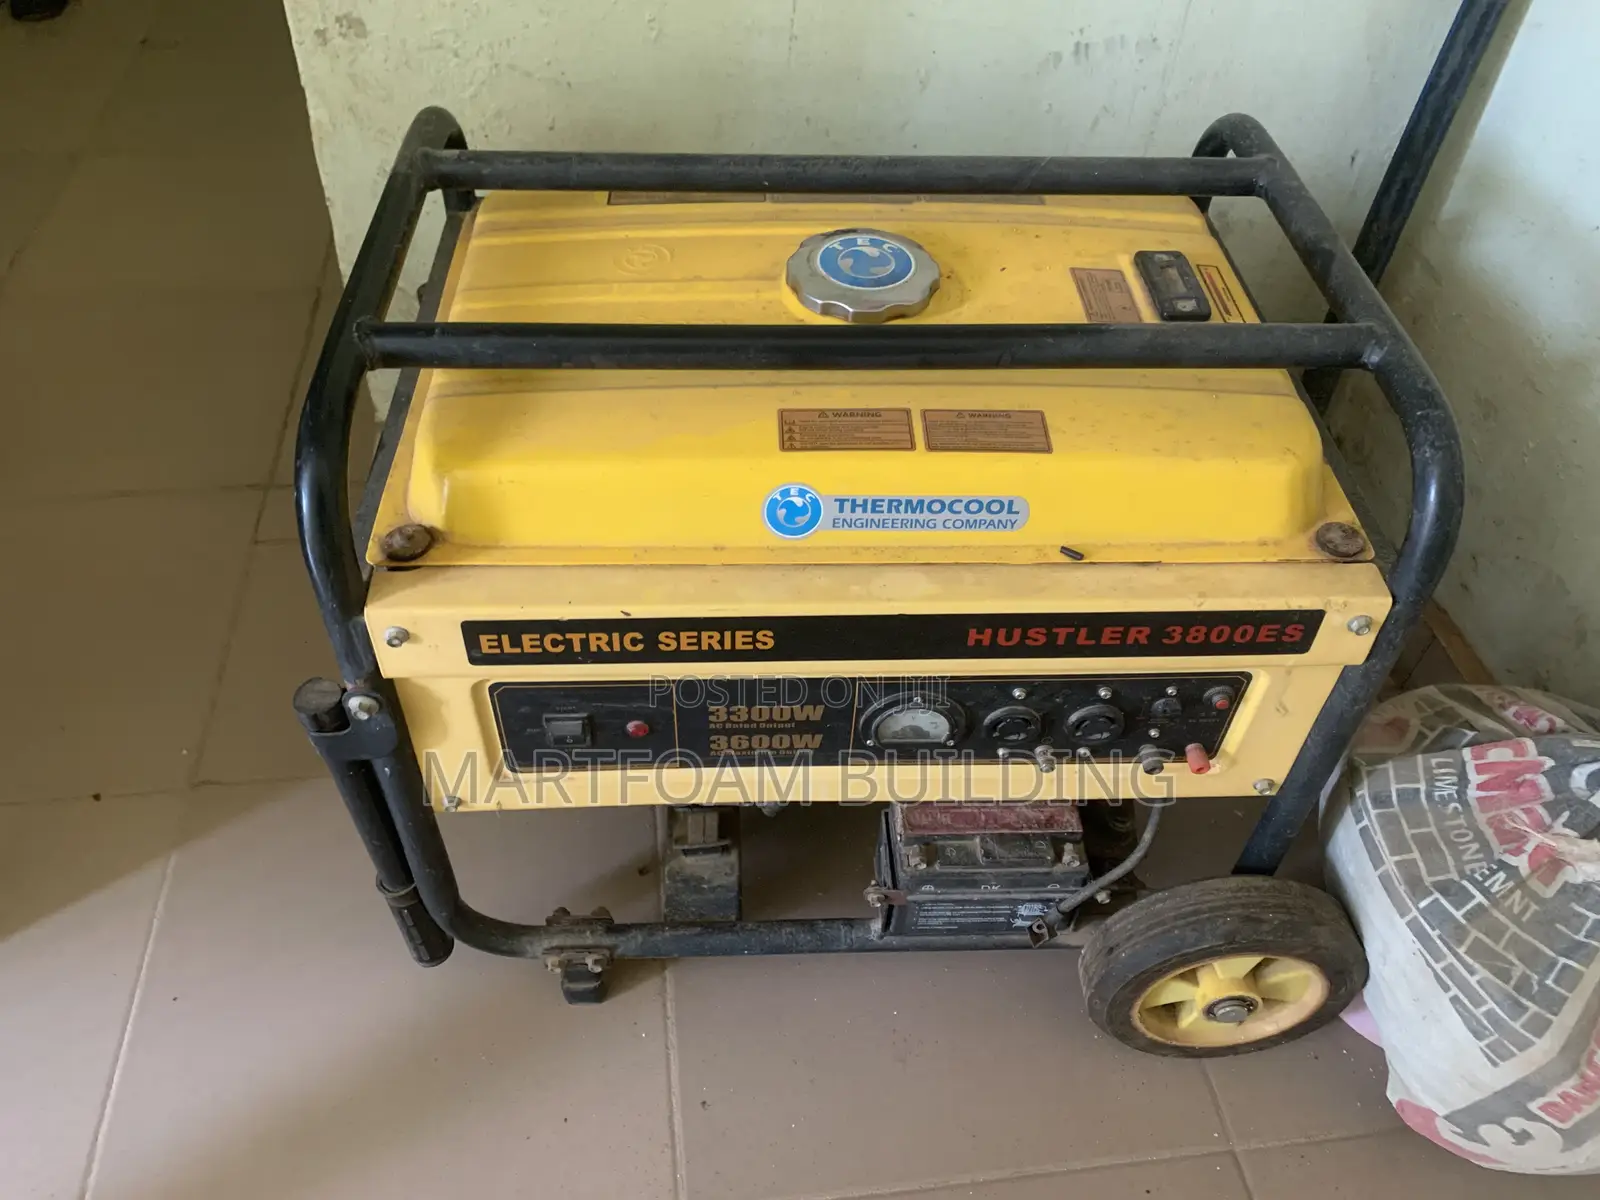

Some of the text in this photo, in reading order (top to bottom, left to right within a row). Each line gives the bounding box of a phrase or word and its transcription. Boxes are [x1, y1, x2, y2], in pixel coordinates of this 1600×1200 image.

[828, 238, 898, 254] TEC
[772, 487, 816, 501] TEC
[833, 498, 1020, 514] THERMOCOOL
[832, 518, 1018, 530] ENGINEERING COMPANY
[479, 630, 775, 654] ELECTRIC SERIES
[966, 623, 1304, 647] HUSTLER 3800ES
[708, 705, 825, 722] 3300W
[709, 734, 823, 750] 3600W
